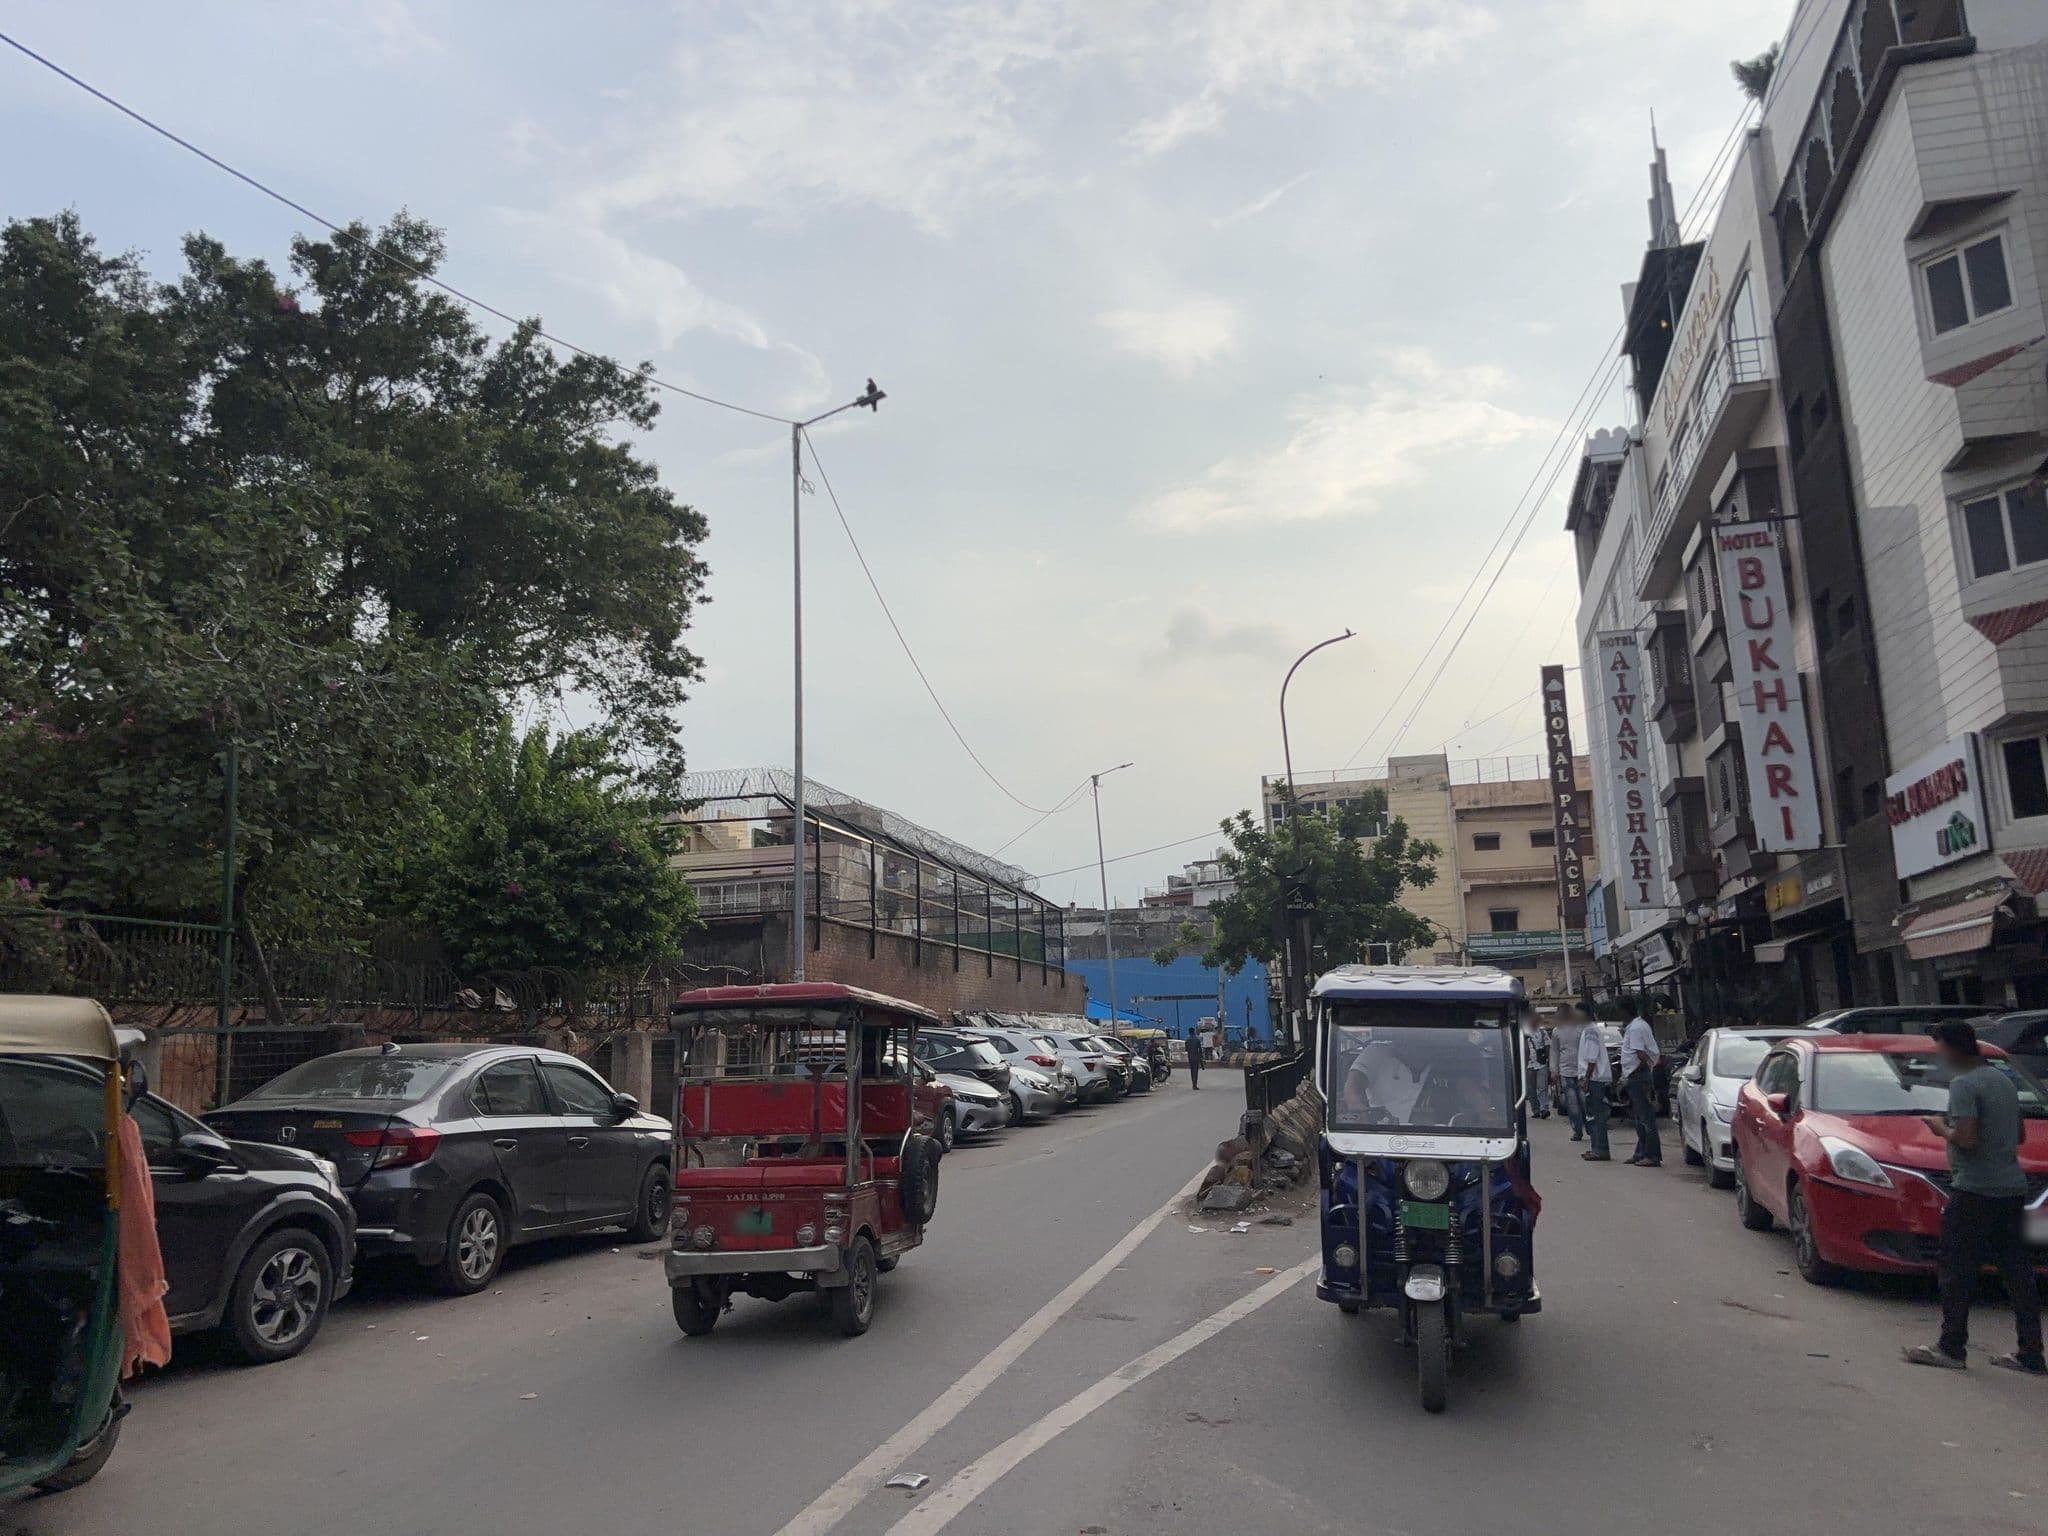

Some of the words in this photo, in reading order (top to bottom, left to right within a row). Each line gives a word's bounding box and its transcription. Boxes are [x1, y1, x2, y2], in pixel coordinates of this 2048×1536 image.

[1719, 531, 1774, 551] HOTEL
[1599, 636, 1637, 648] HOTEL
[1737, 557, 1799, 841] BUKHARI
[1550, 699, 1568, 783] ROYAL
[1559, 795, 1580, 898] PALACE
